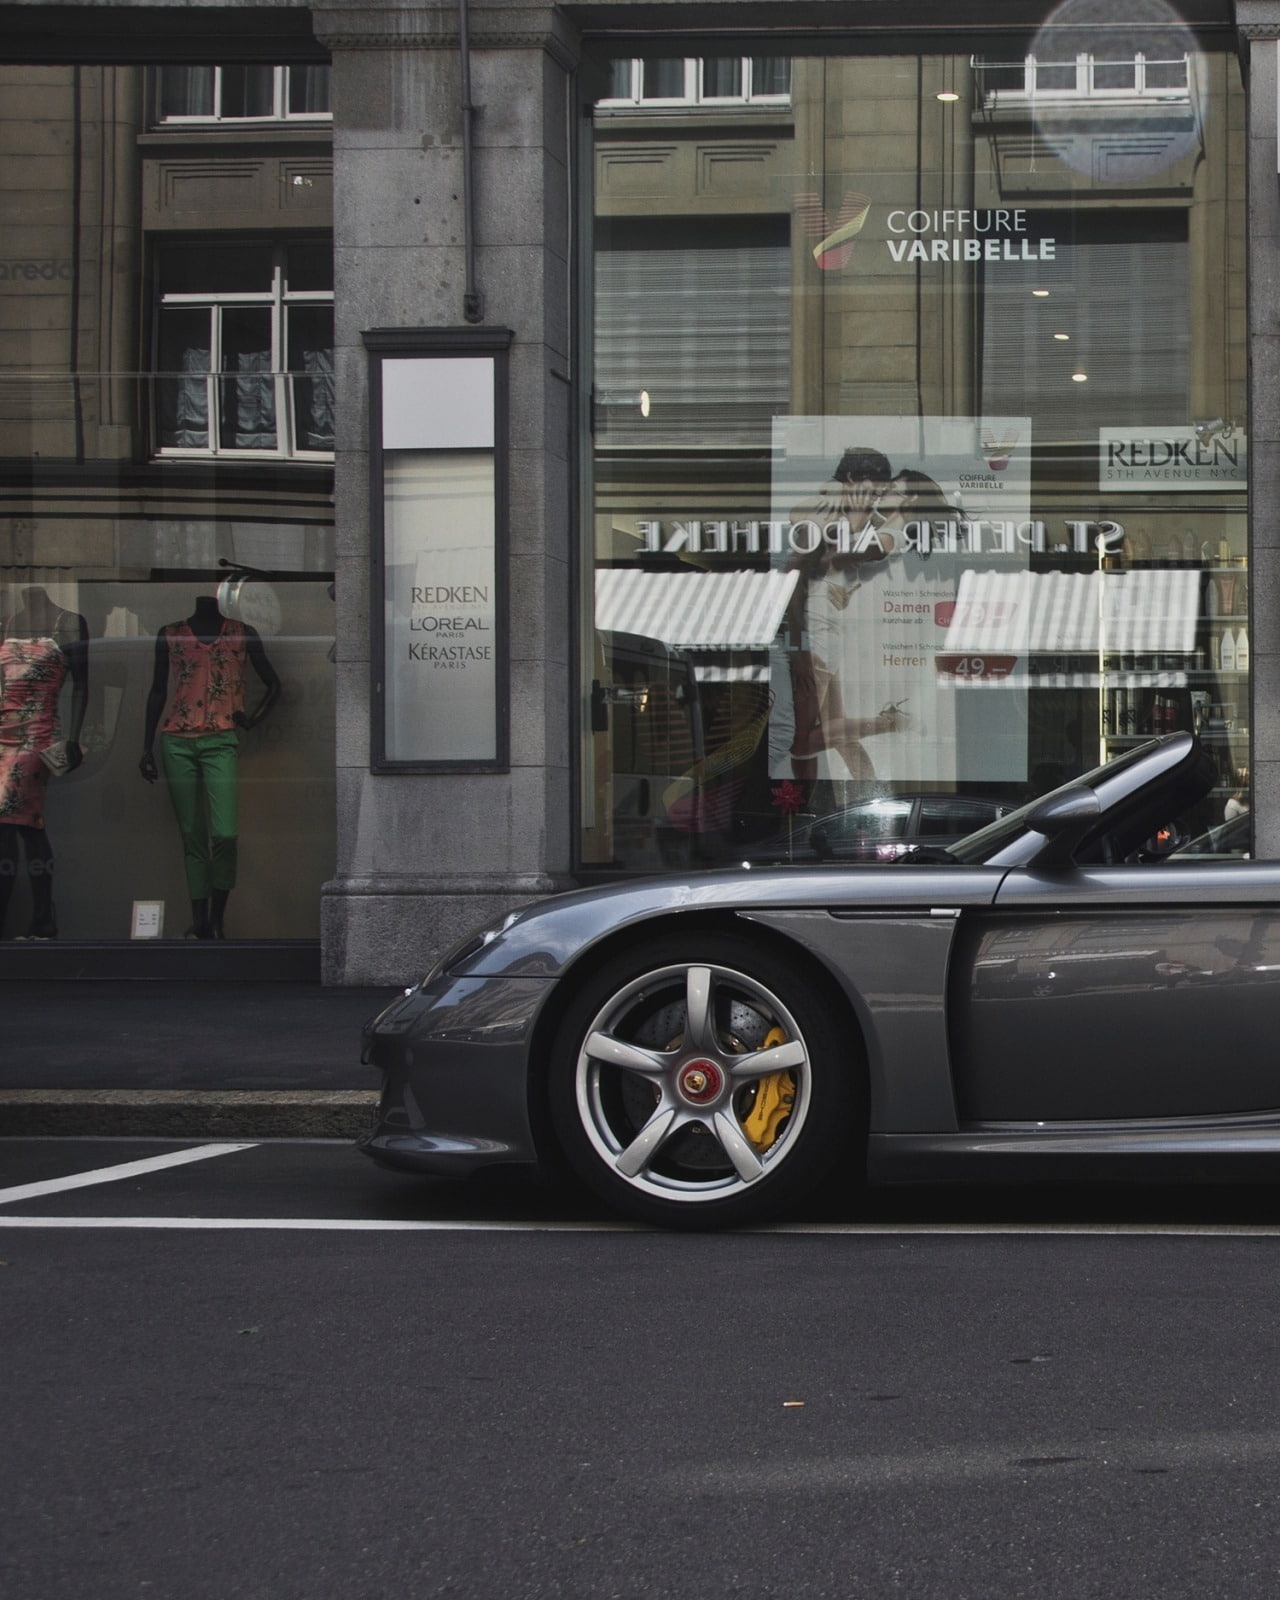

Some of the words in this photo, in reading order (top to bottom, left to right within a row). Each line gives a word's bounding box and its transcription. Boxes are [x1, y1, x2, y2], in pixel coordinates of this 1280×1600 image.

[886, 209, 1027, 234] COIFFURE
[886, 238, 1057, 262] VARIBELLE
[1107, 438, 1239, 467] REDKEN
[959, 474, 997, 482] COIFFURE
[1107, 468, 1134, 479] 5TH
[1144, 468, 1201, 478] AVENUE
[1210, 468, 1239, 478] NYC
[411, 586, 489, 604] REDKEN
[883, 601, 931, 614] Damen
[408, 642, 492, 661] KÉRASTASE
[433, 661, 467, 670] PARIS
[883, 654, 928, 666] Herren
